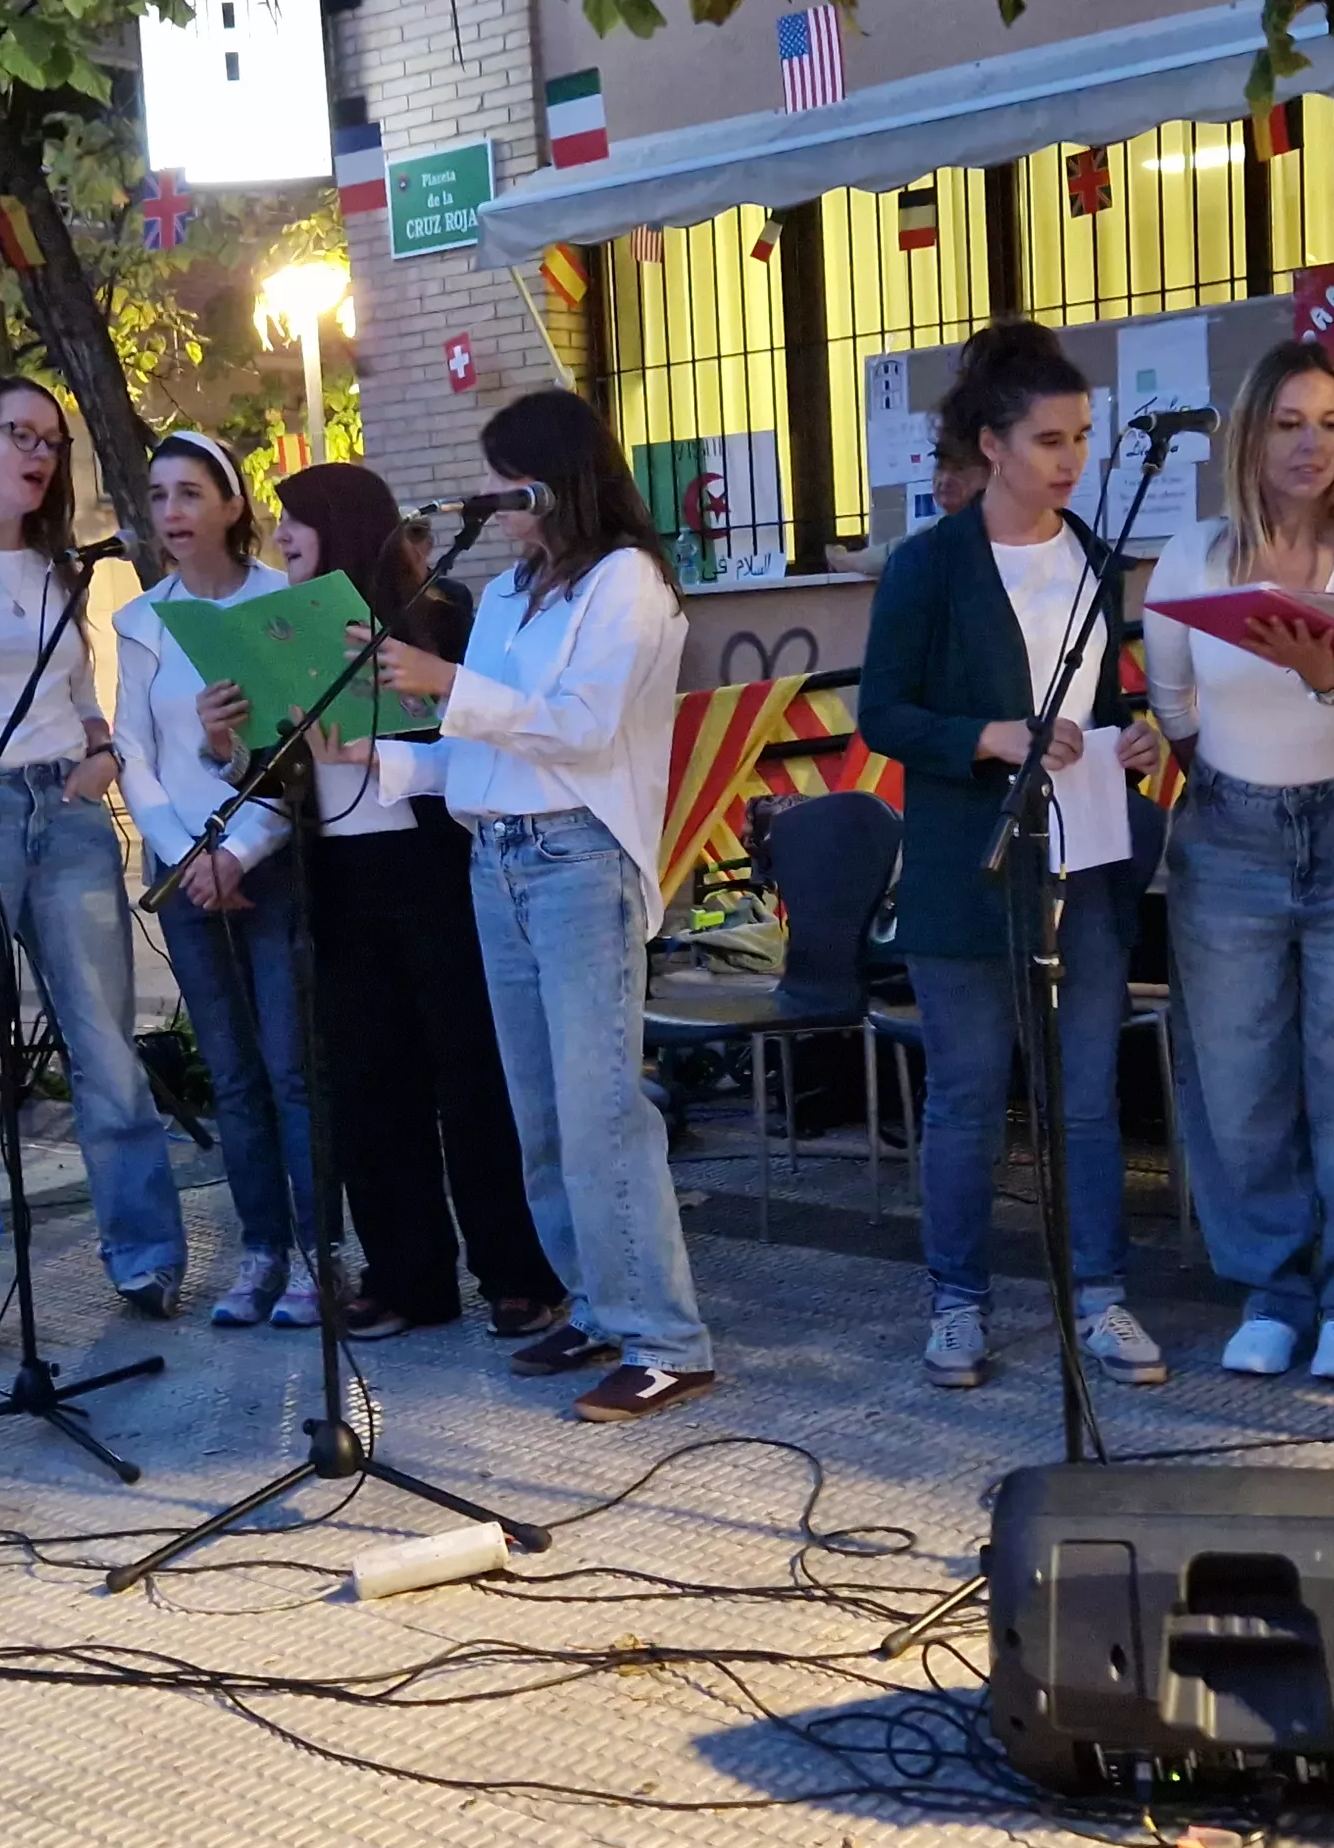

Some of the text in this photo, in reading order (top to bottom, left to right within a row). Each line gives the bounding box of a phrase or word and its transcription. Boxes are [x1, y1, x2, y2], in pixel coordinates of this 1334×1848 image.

[421, 170, 456, 188] Placeta
[427, 190, 454, 208] de la
[406, 207, 479, 239] CRUZ ROJA
